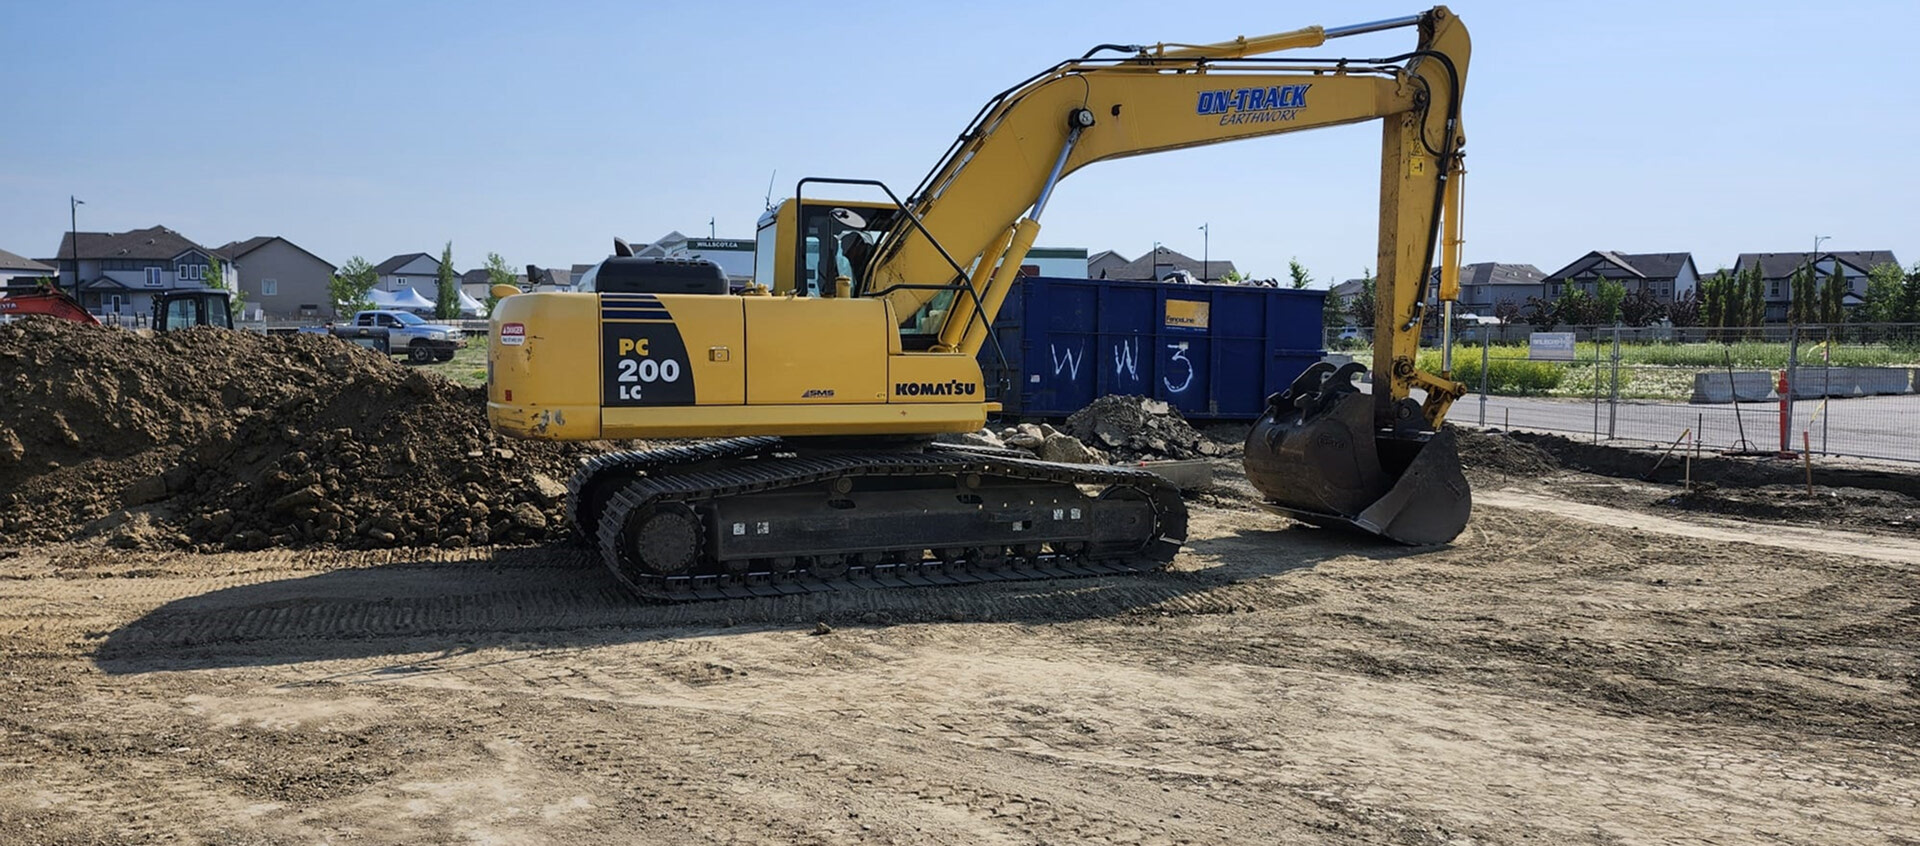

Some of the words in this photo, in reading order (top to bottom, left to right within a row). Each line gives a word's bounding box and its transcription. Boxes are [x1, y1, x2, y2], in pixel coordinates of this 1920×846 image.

[1197, 84, 1312, 114] ON-TRACK
[1219, 108, 1298, 126] EARTHWORX
[619, 338, 649, 356] PC
[618, 359, 680, 382] 200
[1051, 339, 1085, 381] W
[1114, 336, 1139, 381] W
[1163, 344, 1193, 393] 3
[620, 385, 642, 399] LC
[895, 379, 976, 396] KOMATSU
